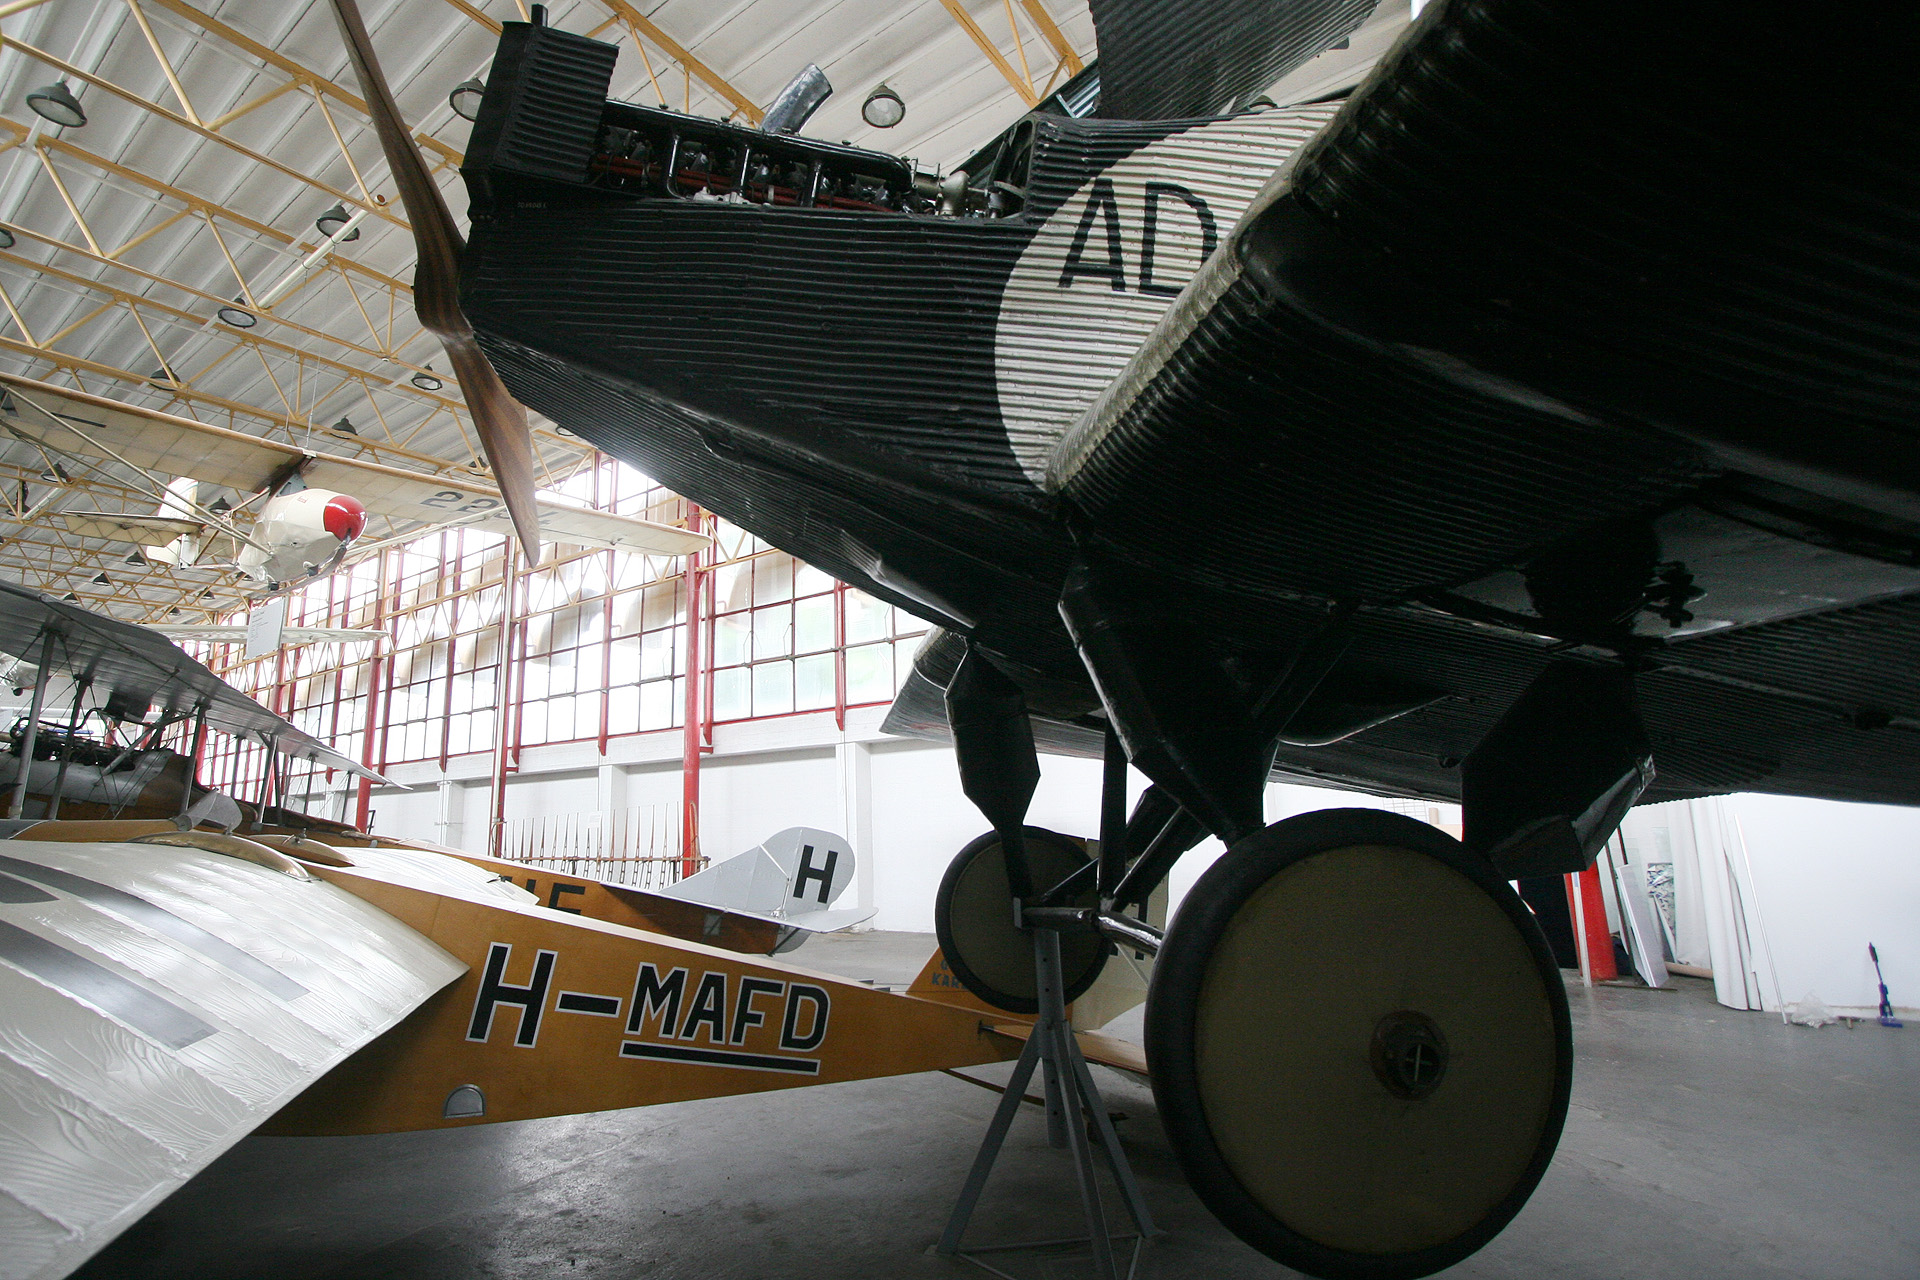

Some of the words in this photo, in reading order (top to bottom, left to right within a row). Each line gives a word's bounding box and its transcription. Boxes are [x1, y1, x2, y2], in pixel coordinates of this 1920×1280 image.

[1058, 177, 1218, 298] AD
[793, 845, 839, 904] H
[465, 942, 832, 1053] H-MAFD
